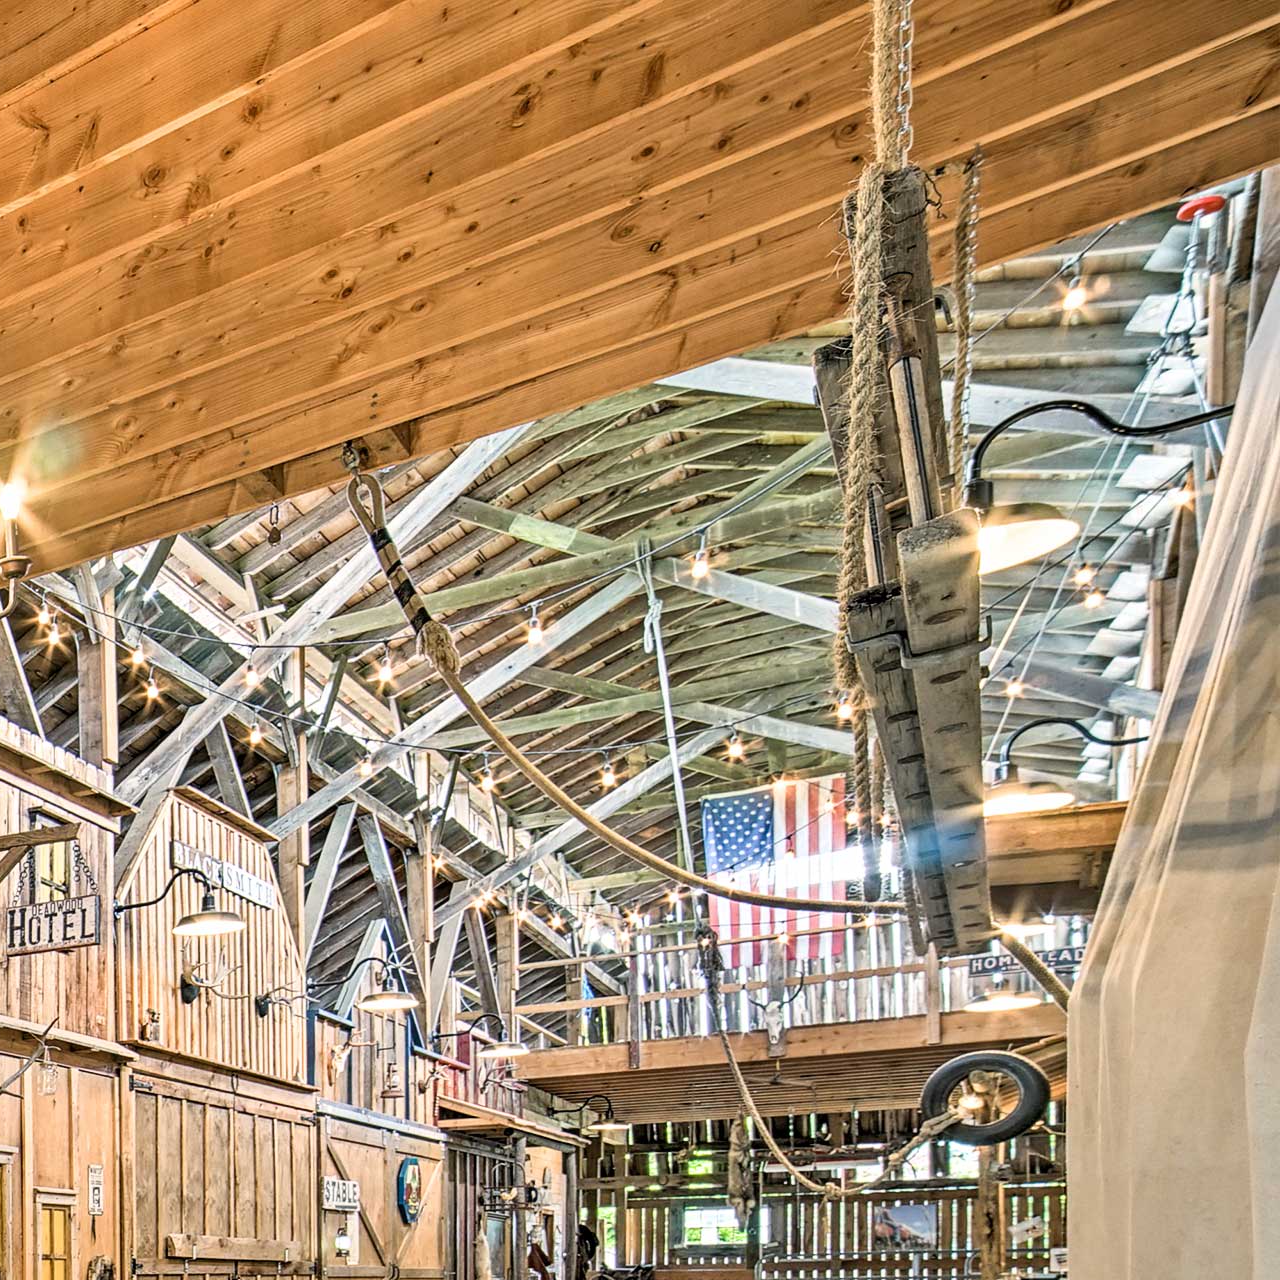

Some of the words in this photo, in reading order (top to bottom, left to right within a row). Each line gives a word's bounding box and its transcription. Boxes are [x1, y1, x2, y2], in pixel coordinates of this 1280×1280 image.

[32, 898, 83, 917] DEADWOOD
[7, 907, 95, 949] HOTEL
[972, 948, 1086, 972] HOMTEAD
[325, 1180, 358, 1203] STABLE
